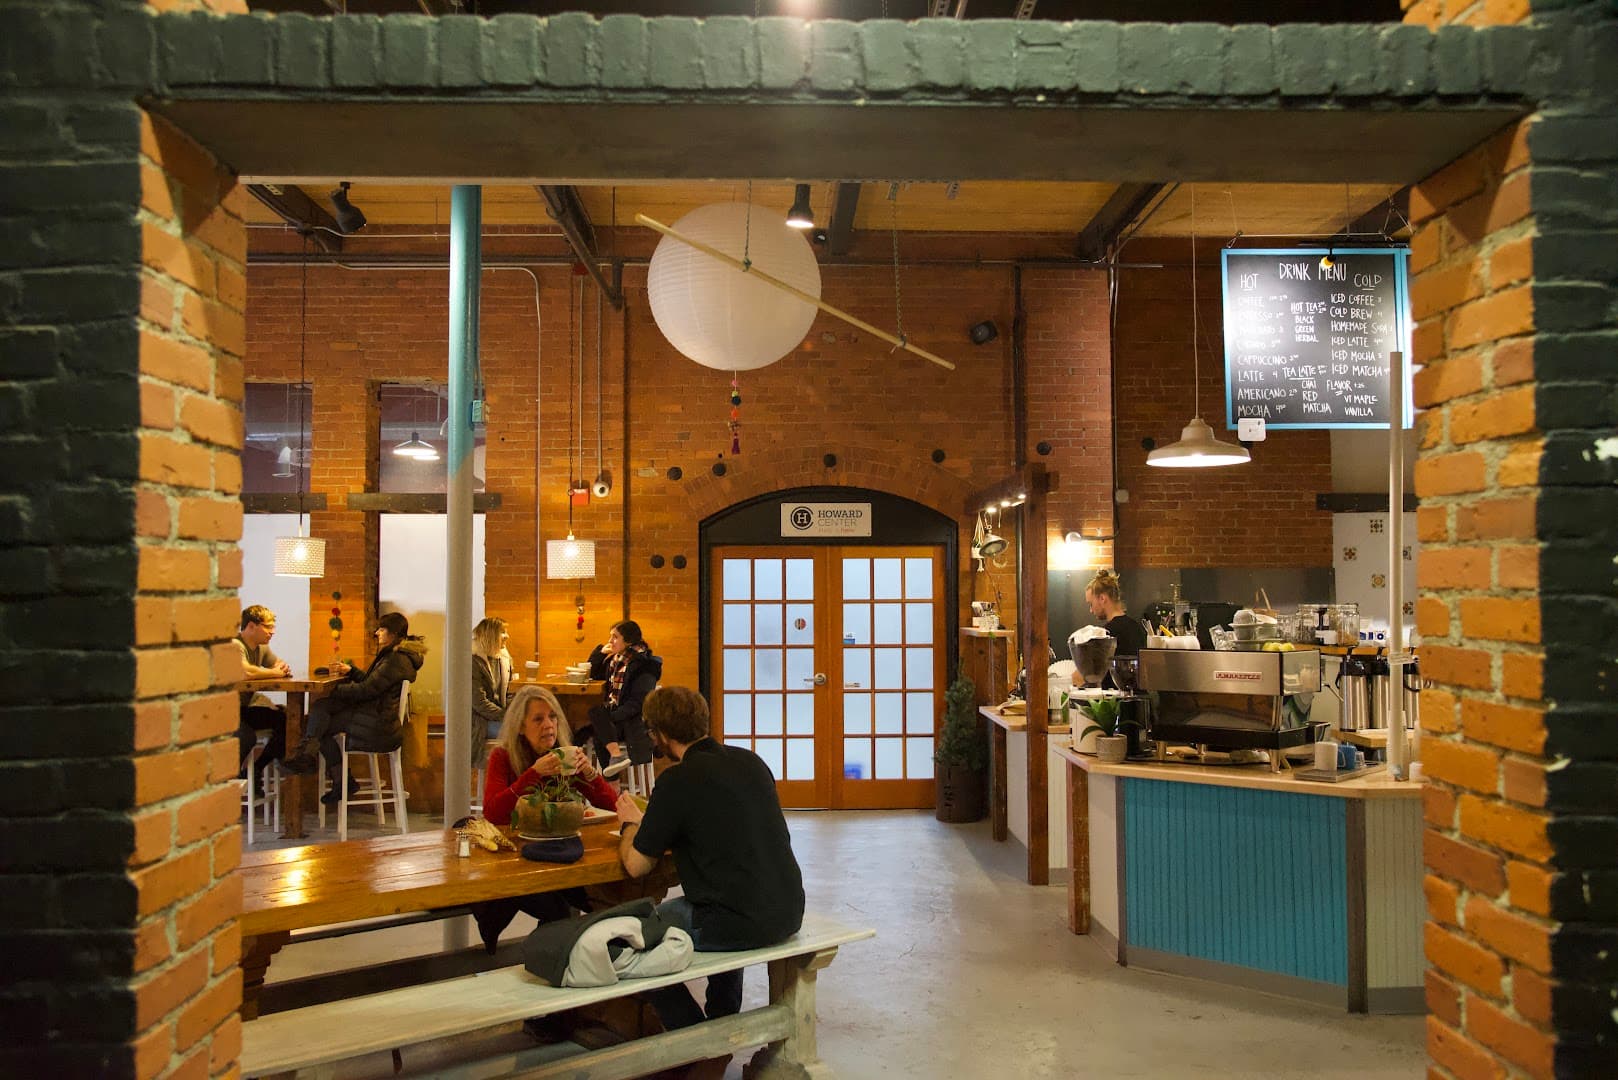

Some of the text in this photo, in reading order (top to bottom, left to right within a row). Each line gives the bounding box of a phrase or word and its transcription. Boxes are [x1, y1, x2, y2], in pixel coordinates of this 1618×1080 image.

[1279, 262, 1347, 281] DRINK MENU
[1240, 273, 1259, 290] HOT
[1354, 273, 1382, 290] COLD
[1330, 293, 1346, 303] ICED
[1348, 294, 1375, 306] COFFEE
[1290, 301, 1303, 314] HOT
[1305, 301, 1318, 314] TEA
[1329, 306, 1348, 318] COLD
[1350, 307, 1373, 320] BREW
[1295, 315, 1315, 324] BLACK
[1294, 325, 1315, 334] GREEN
[1330, 320, 1369, 335] HOMEMADE
[1295, 334, 1319, 343] HERBAL
[1331, 336, 1346, 346] ICED
[1347, 336, 1369, 348] LATTE
[1237, 354, 1287, 366] CAPPUCCINO
[1331, 349, 1348, 361] ICED
[1350, 350, 1376, 363] MOCHA
[1238, 370, 1265, 382] LATTE
[1282, 366, 1297, 381] TEA
[1298, 365, 1317, 379] LATTE
[1331, 363, 1349, 375] ICED
[1352, 364, 1383, 378] MATCHA
[1301, 380, 1317, 390] CHAI
[1326, 379, 1353, 393] FLAVOR
[1237, 387, 1287, 401] AMERICANO
[1302, 390, 1319, 402] RED
[1353, 394, 1379, 405] MAPLE
[1237, 404, 1272, 418] MOCHA
[1302, 402, 1333, 414] MATCHA
[1344, 406, 1374, 417] VANILLA
[818, 510, 863, 518] HOWARD
[817, 518, 858, 527] CENTER
